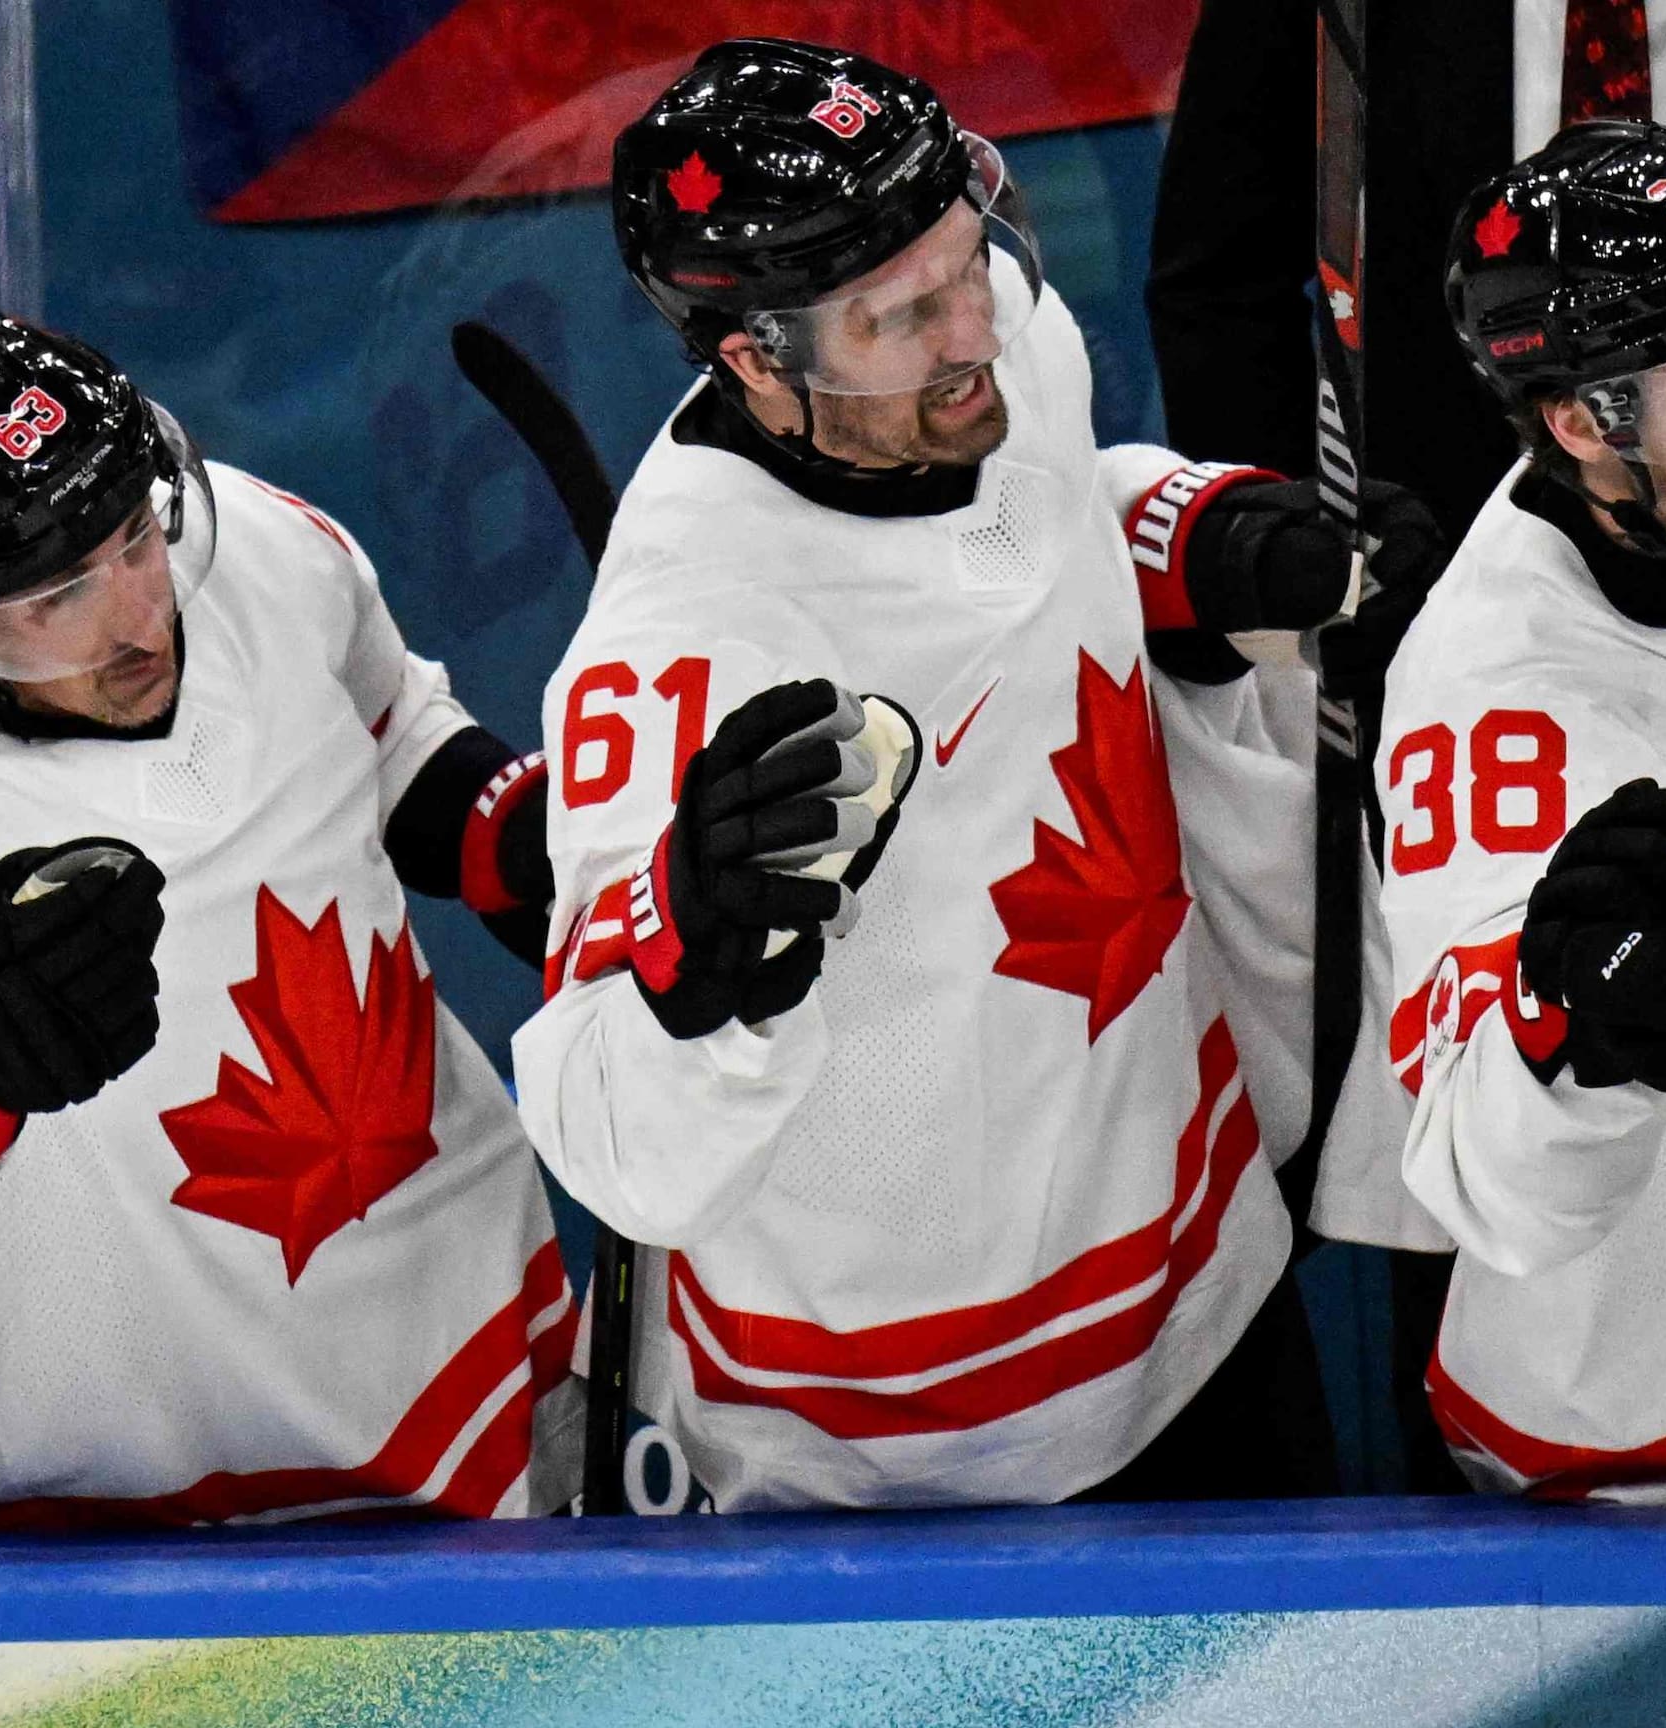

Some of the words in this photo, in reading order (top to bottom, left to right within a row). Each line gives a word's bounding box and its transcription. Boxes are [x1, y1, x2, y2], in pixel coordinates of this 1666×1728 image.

[808, 82, 882, 138] 61
[1490, 328, 1544, 357] CCM
[562, 657, 711, 811] 61
[1389, 709, 1566, 876] 38
[1601, 931, 1642, 981] CCM
